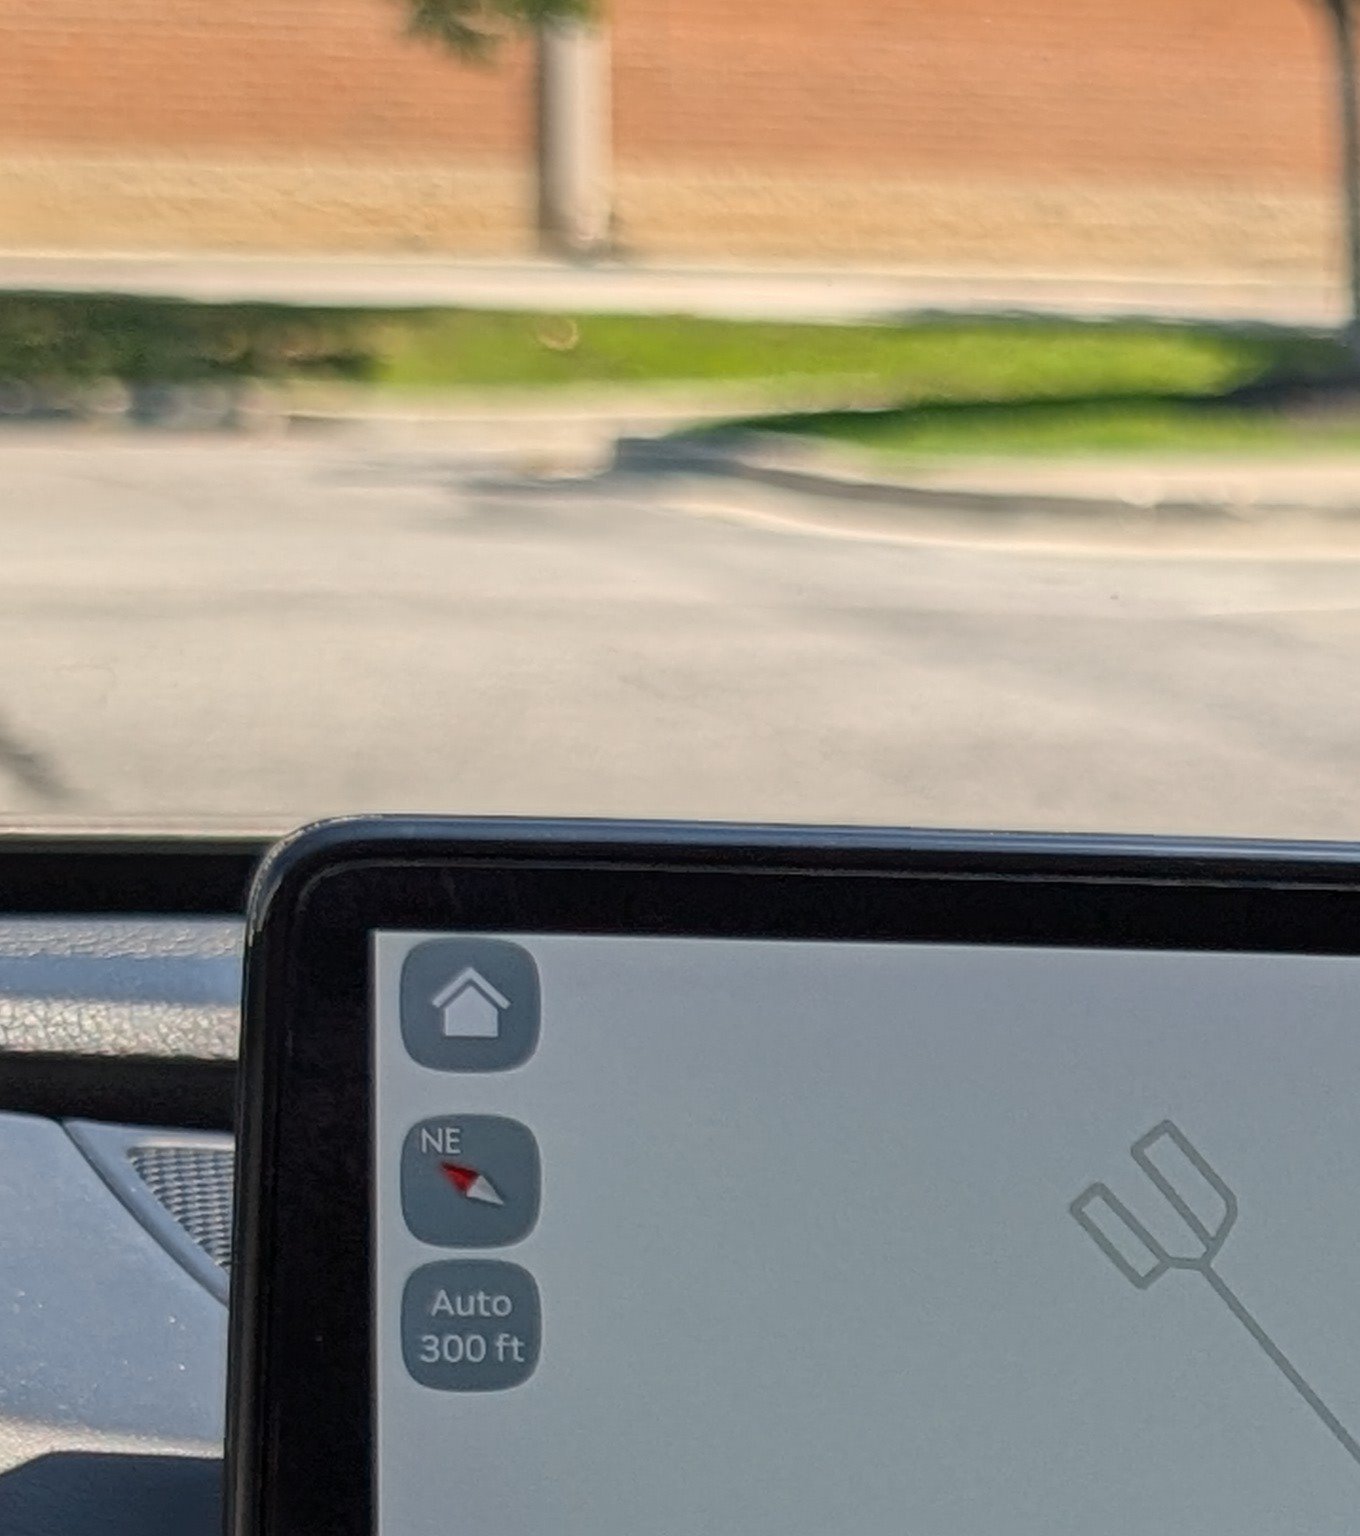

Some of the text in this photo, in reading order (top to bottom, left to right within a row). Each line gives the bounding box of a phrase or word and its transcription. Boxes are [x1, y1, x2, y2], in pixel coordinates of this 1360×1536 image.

[420, 1127, 462, 1155] NE
[430, 1289, 513, 1318] Auto
[419, 1333, 525, 1364] 300 ft
